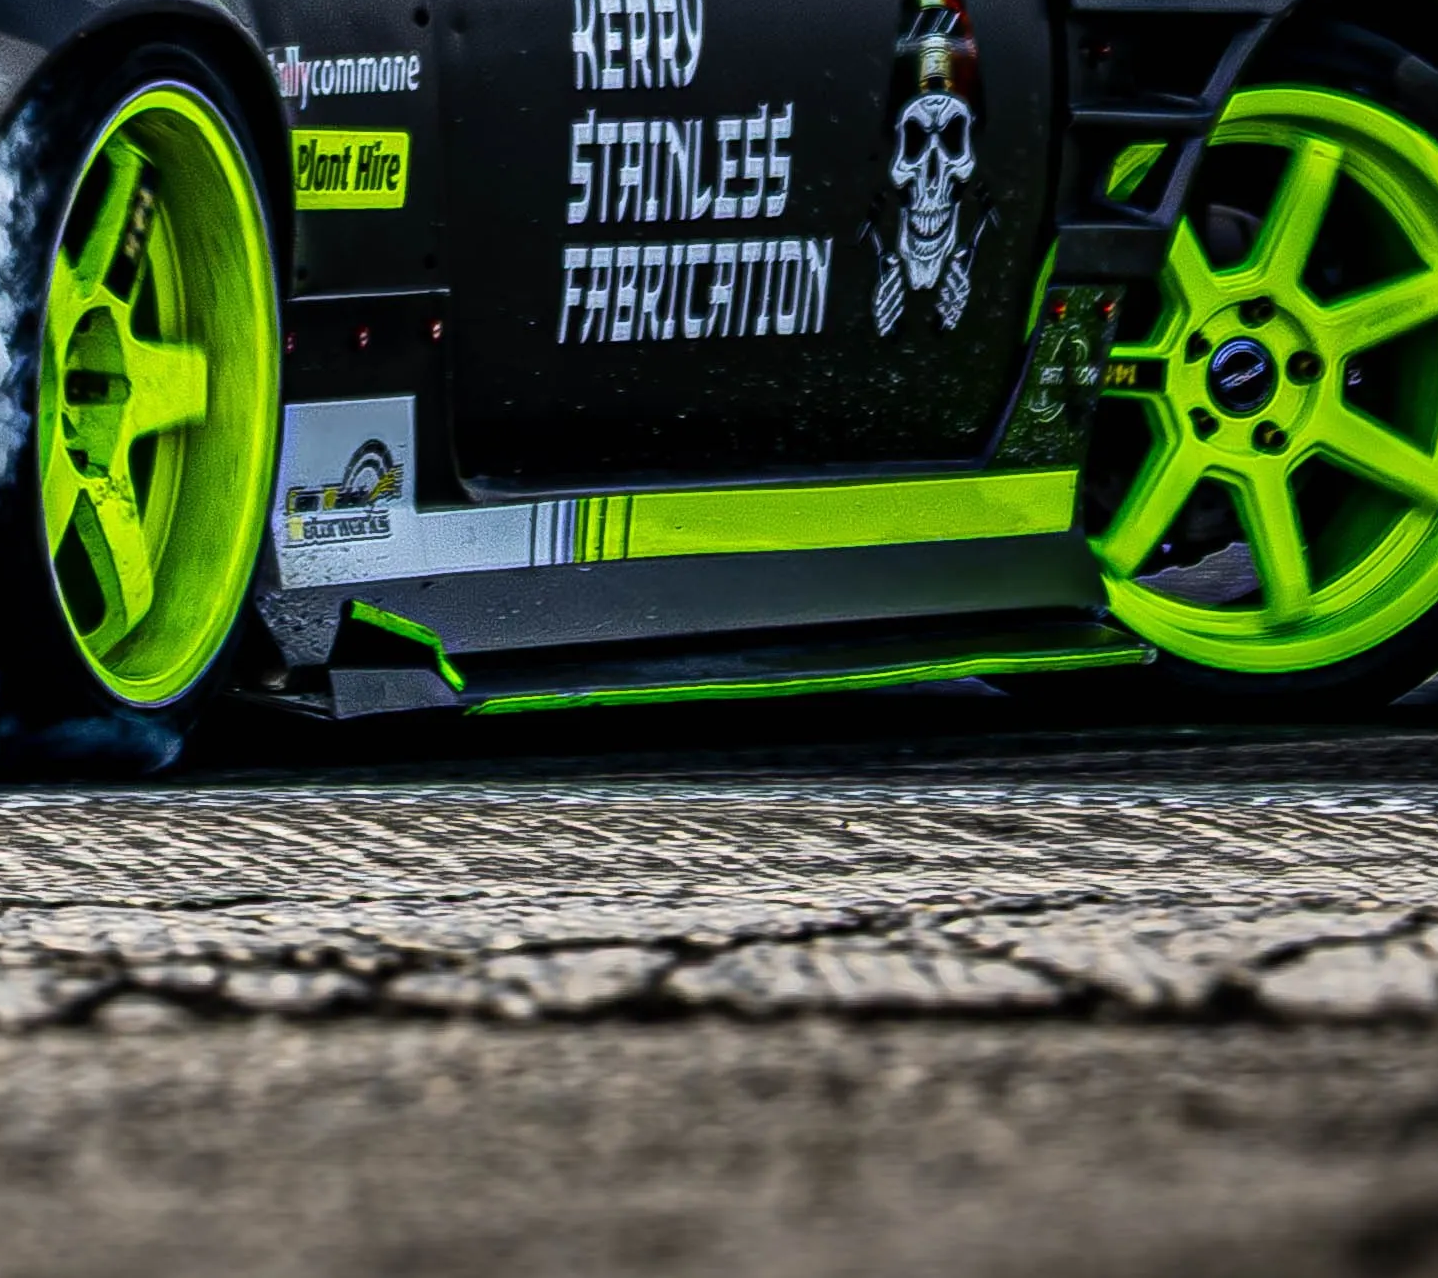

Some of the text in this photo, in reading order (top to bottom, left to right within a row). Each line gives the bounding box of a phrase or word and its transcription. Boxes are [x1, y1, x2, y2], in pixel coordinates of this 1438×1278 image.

[297, 139, 401, 191] Plant Hire
[566, 100, 794, 225] STAINLESS
[557, 237, 834, 344] FABRICATION
